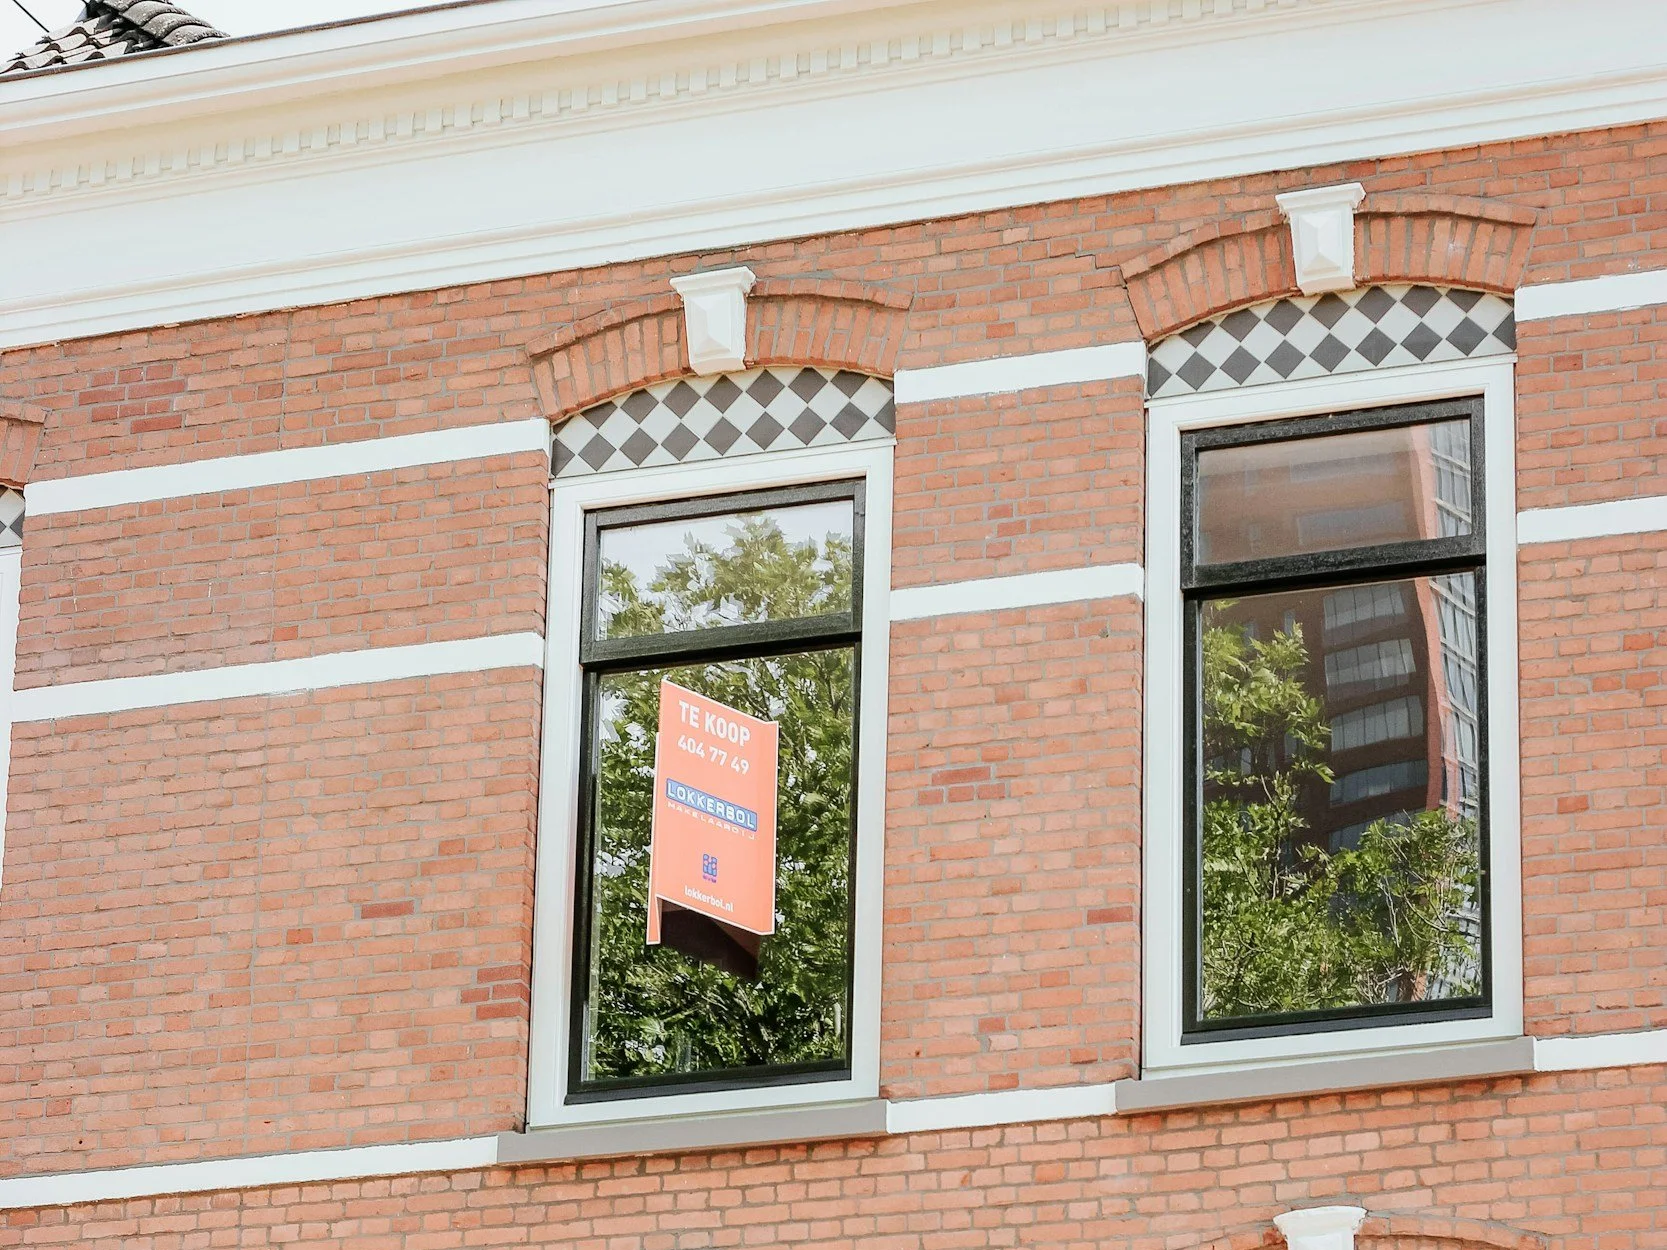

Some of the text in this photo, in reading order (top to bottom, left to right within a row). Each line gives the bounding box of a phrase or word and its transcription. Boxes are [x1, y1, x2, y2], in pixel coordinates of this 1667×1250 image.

[678, 700, 751, 747] TE KOOP
[677, 735, 750, 775] 404 77 49
[667, 782, 755, 828] LOKKERBOL
[667, 802, 755, 840] MAKELAARDIJ
[684, 885, 734, 912] lokkerbol.nl
